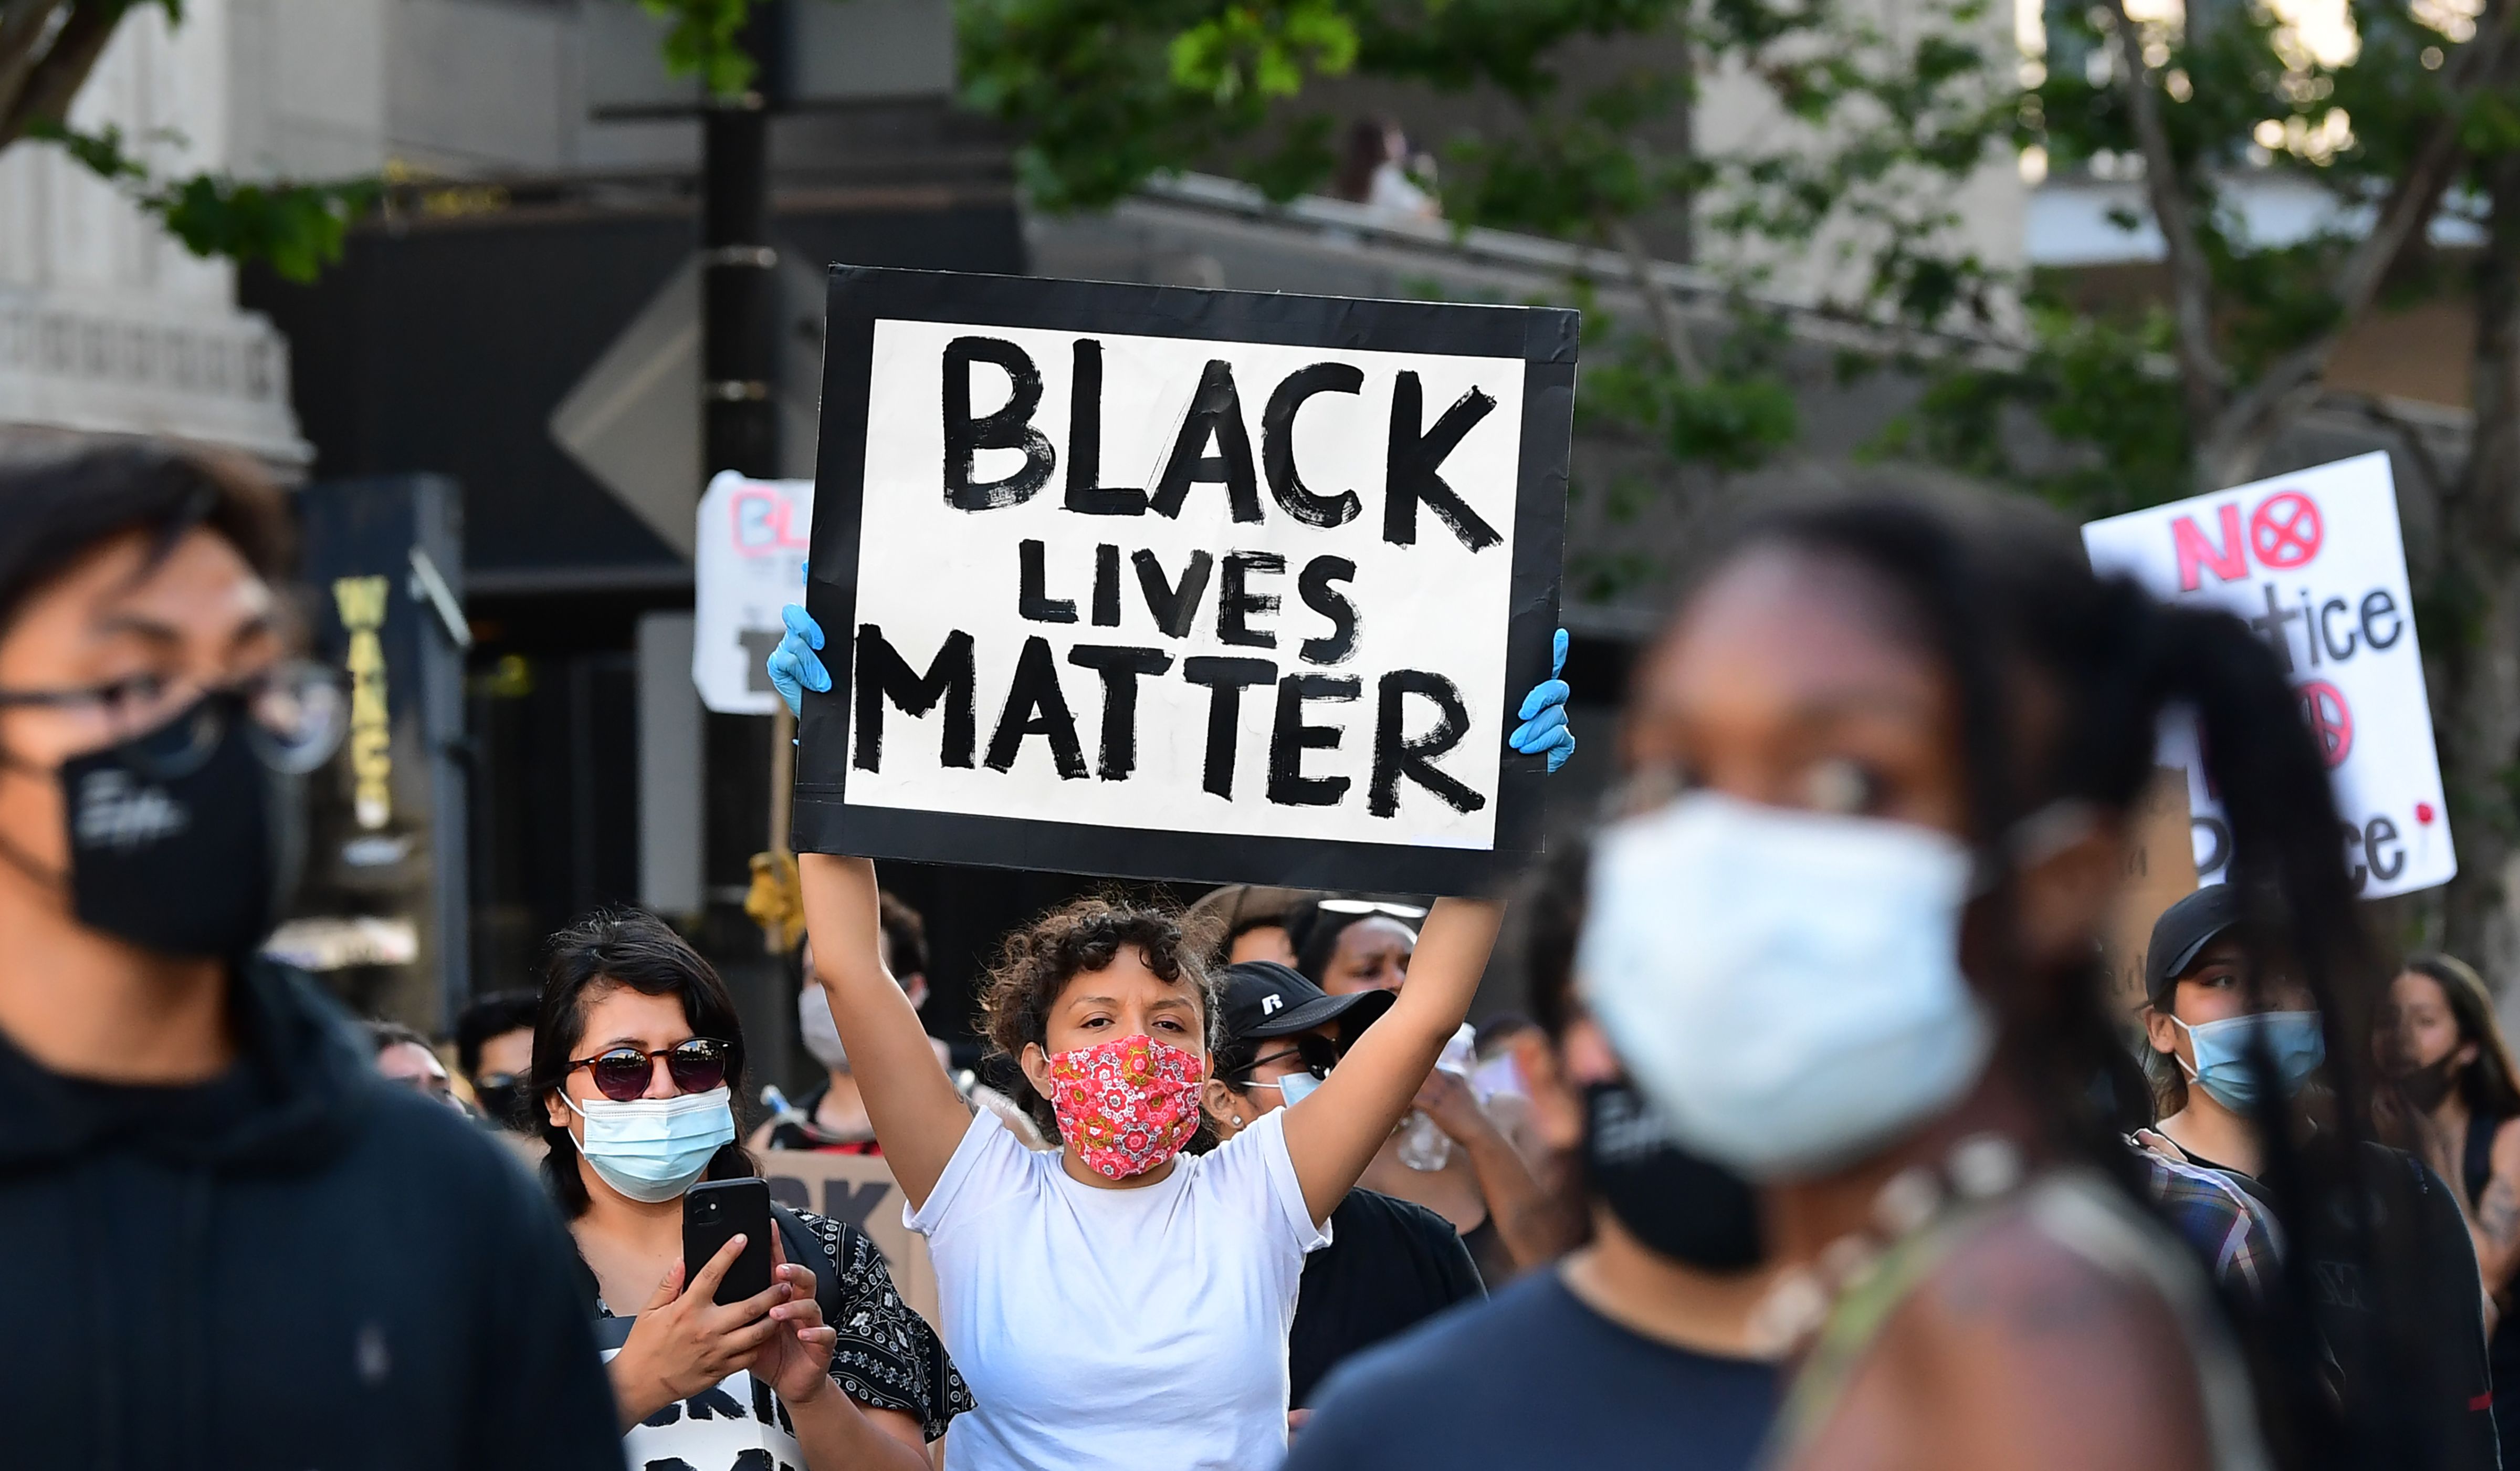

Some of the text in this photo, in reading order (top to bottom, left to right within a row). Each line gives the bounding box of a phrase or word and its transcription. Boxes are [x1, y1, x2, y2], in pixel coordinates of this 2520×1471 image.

[942, 336, 1505, 553] BLACK
[1018, 539, 1362, 665] LIVES
[2172, 492, 2323, 592] NO
[2251, 584, 2402, 673] tice
[852, 623, 1487, 818] MATTER
